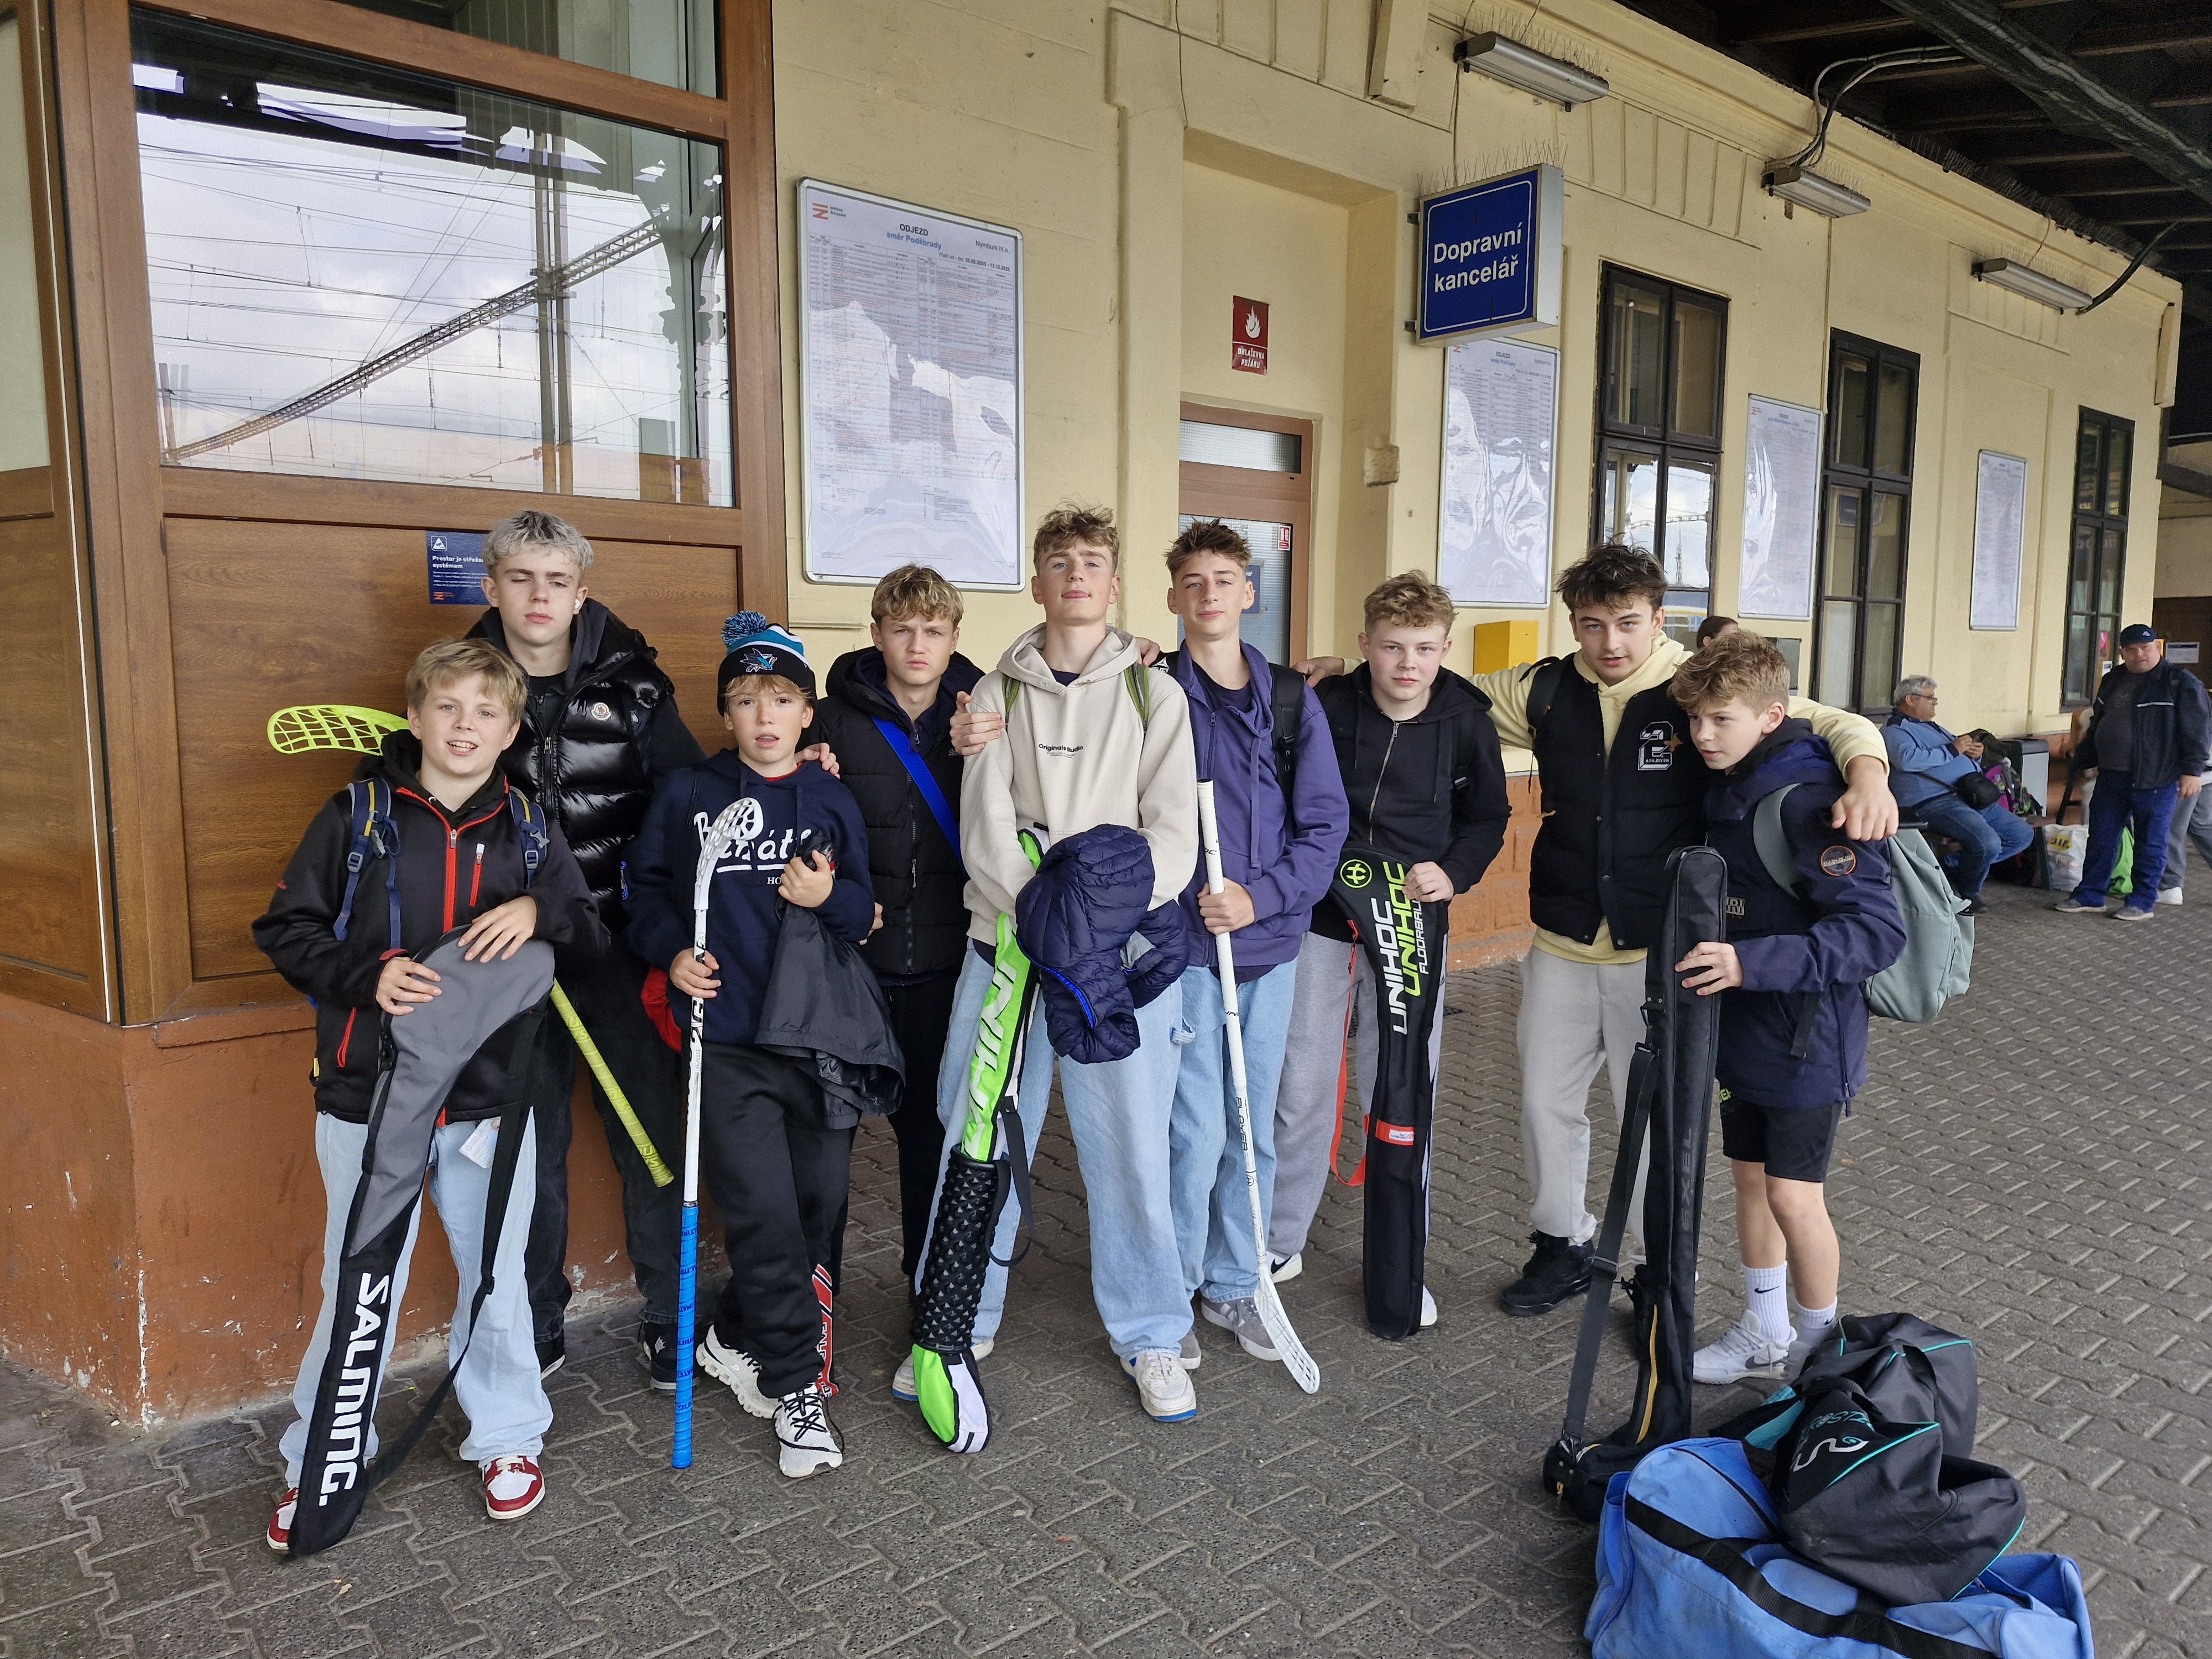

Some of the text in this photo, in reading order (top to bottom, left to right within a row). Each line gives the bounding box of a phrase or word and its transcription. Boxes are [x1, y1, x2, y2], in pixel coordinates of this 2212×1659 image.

[899, 223, 928, 236] ODJEZD
[886, 232, 942, 251] směr Poděbrady
[975, 240, 998, 251] Nymburk
[1434, 222, 1522, 264] Dopravní
[990, 263, 1010, 272] 13.12.2025
[1434, 254, 1519, 293] kancelář
[1238, 346, 1264, 359] OHLAŠOVNA
[1241, 358, 1260, 369] POŽÁRU
[1039, 743, 1066, 752] Originals
[1383, 861, 1422, 997] UNIHOC
[1371, 898, 1408, 1035] UNIHOC
[1682, 1127, 1692, 1232] EXEL
